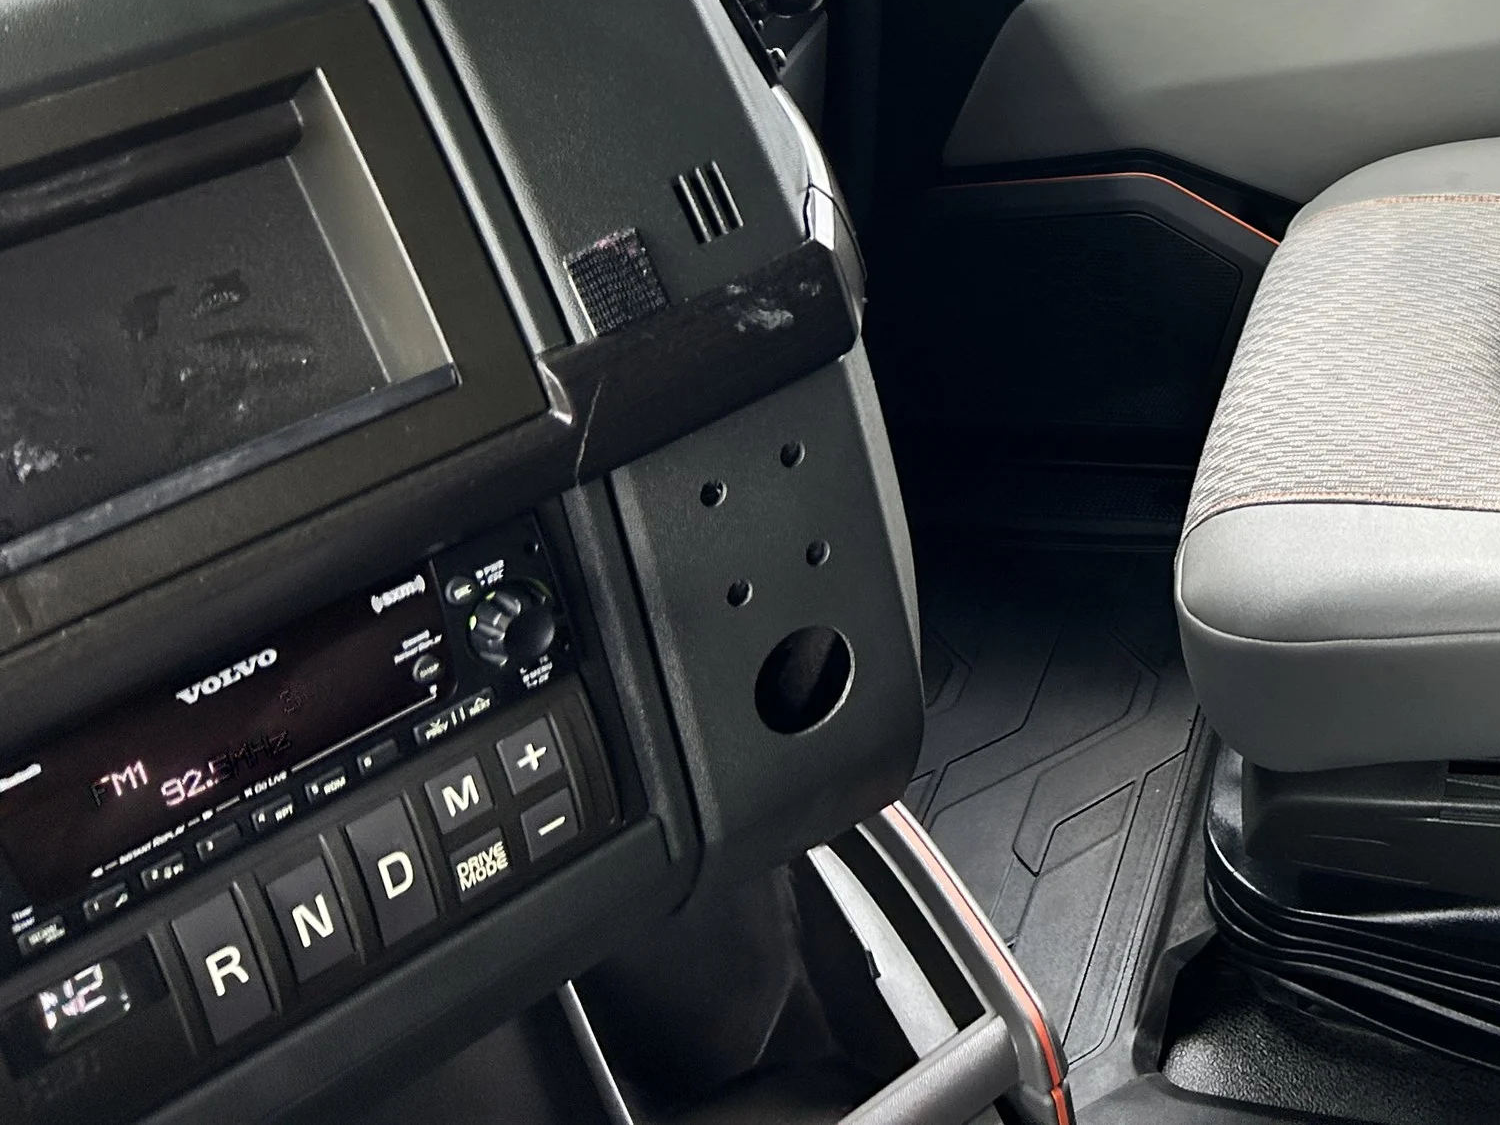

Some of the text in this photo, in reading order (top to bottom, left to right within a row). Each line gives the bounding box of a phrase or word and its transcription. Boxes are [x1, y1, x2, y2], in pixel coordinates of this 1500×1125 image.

[175, 648, 278, 705] VOLVO
[91, 760, 148, 807] FM1
[441, 774, 480, 817] M
[274, 803, 294, 822] RPT
[377, 850, 414, 900] D
[456, 841, 505, 877] DRIVE
[459, 857, 509, 892] MODE
[292, 892, 334, 948] N
[205, 945, 249, 997] R
